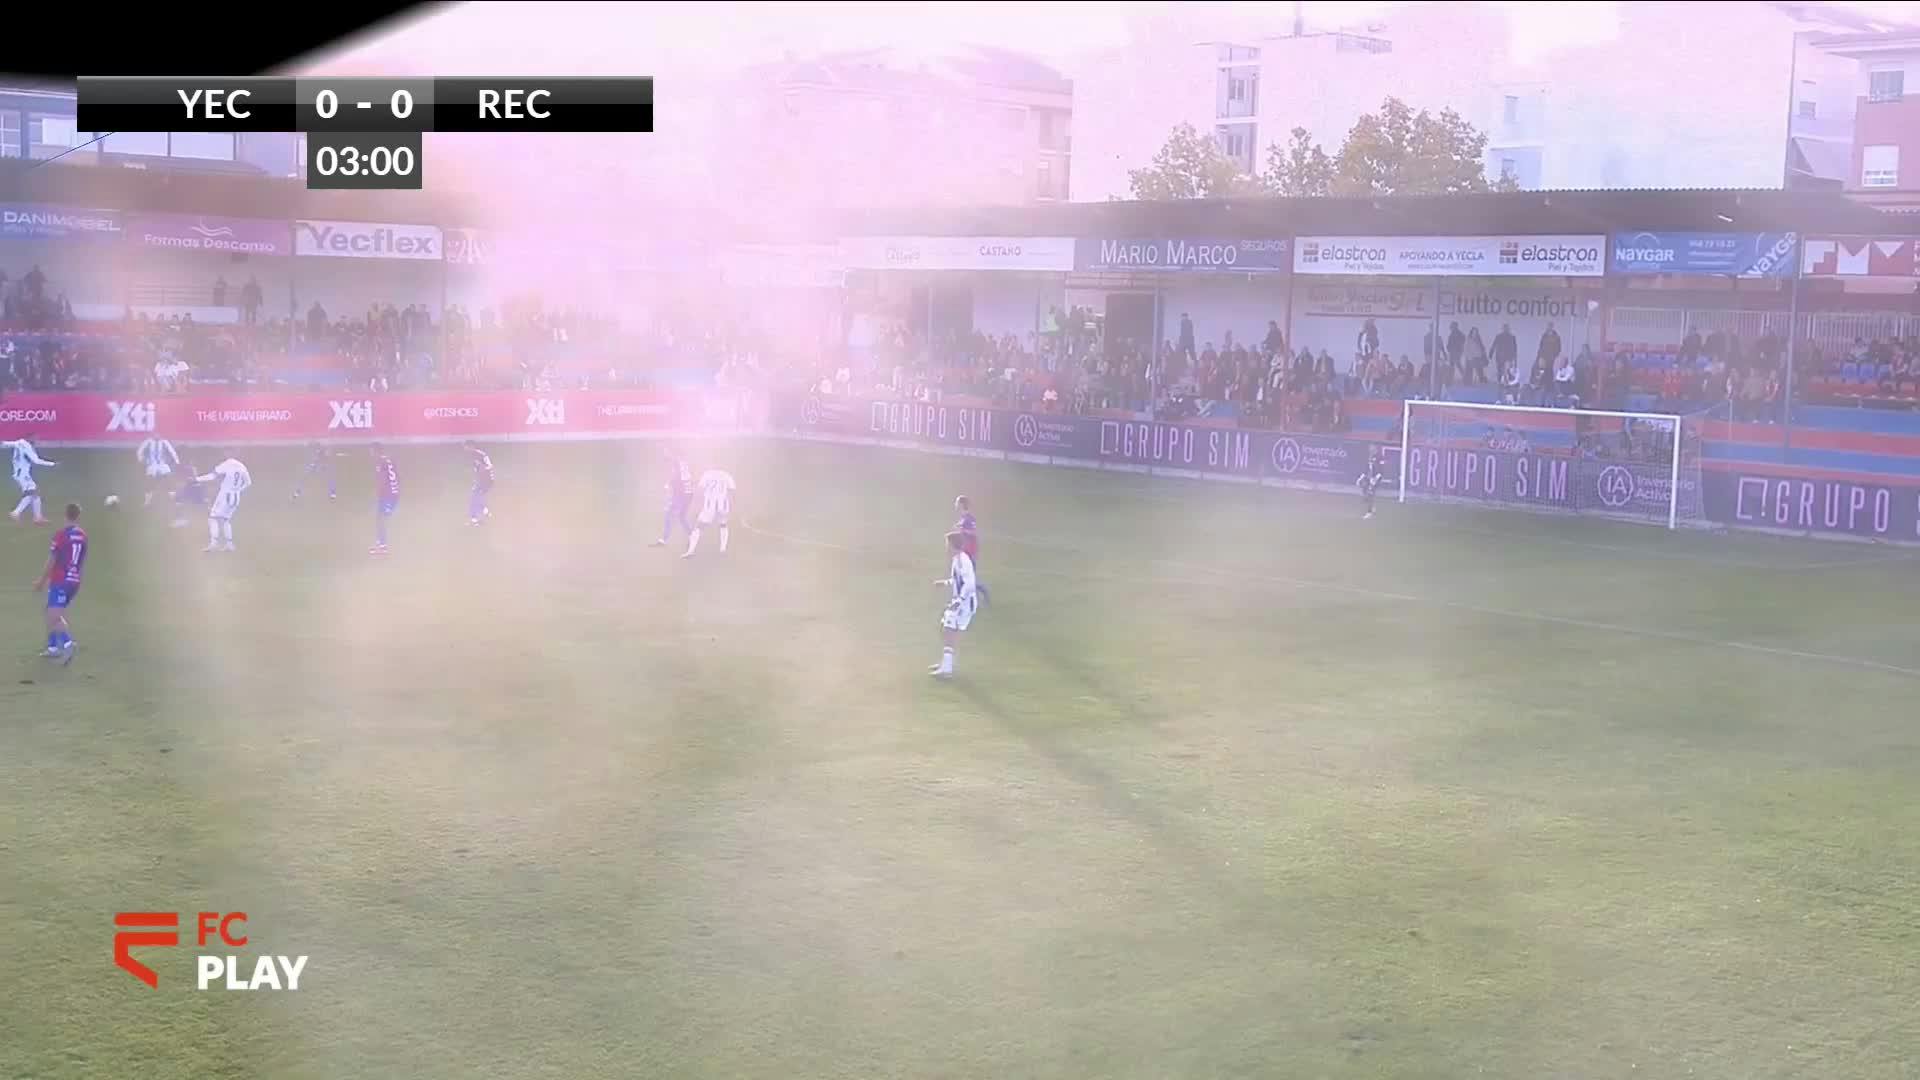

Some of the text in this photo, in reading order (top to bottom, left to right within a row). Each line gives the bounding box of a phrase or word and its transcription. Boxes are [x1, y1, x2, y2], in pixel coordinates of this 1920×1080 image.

[144, 233, 275, 253] Formas Descanso
[312, 225, 433, 255] Yecflex
[1101, 239, 1237, 266] MARIO MARCO
[1321, 244, 1386, 261] elastron
[1521, 244, 1598, 263] elastron
[1455, 291, 1577, 317] tutto confort
[106, 401, 156, 432] Xti
[196, 410, 218, 421] THE
[328, 400, 373, 429] Xti
[889, 403, 947, 440] GRUPO
[958, 408, 992, 443] SIM
[1123, 422, 1250, 469] GRUPO SIM
[1409, 447, 1568, 501] GRUPO SIM
[1774, 479, 1891, 533] GRUPO
[71, 543, 82, 565] 11
